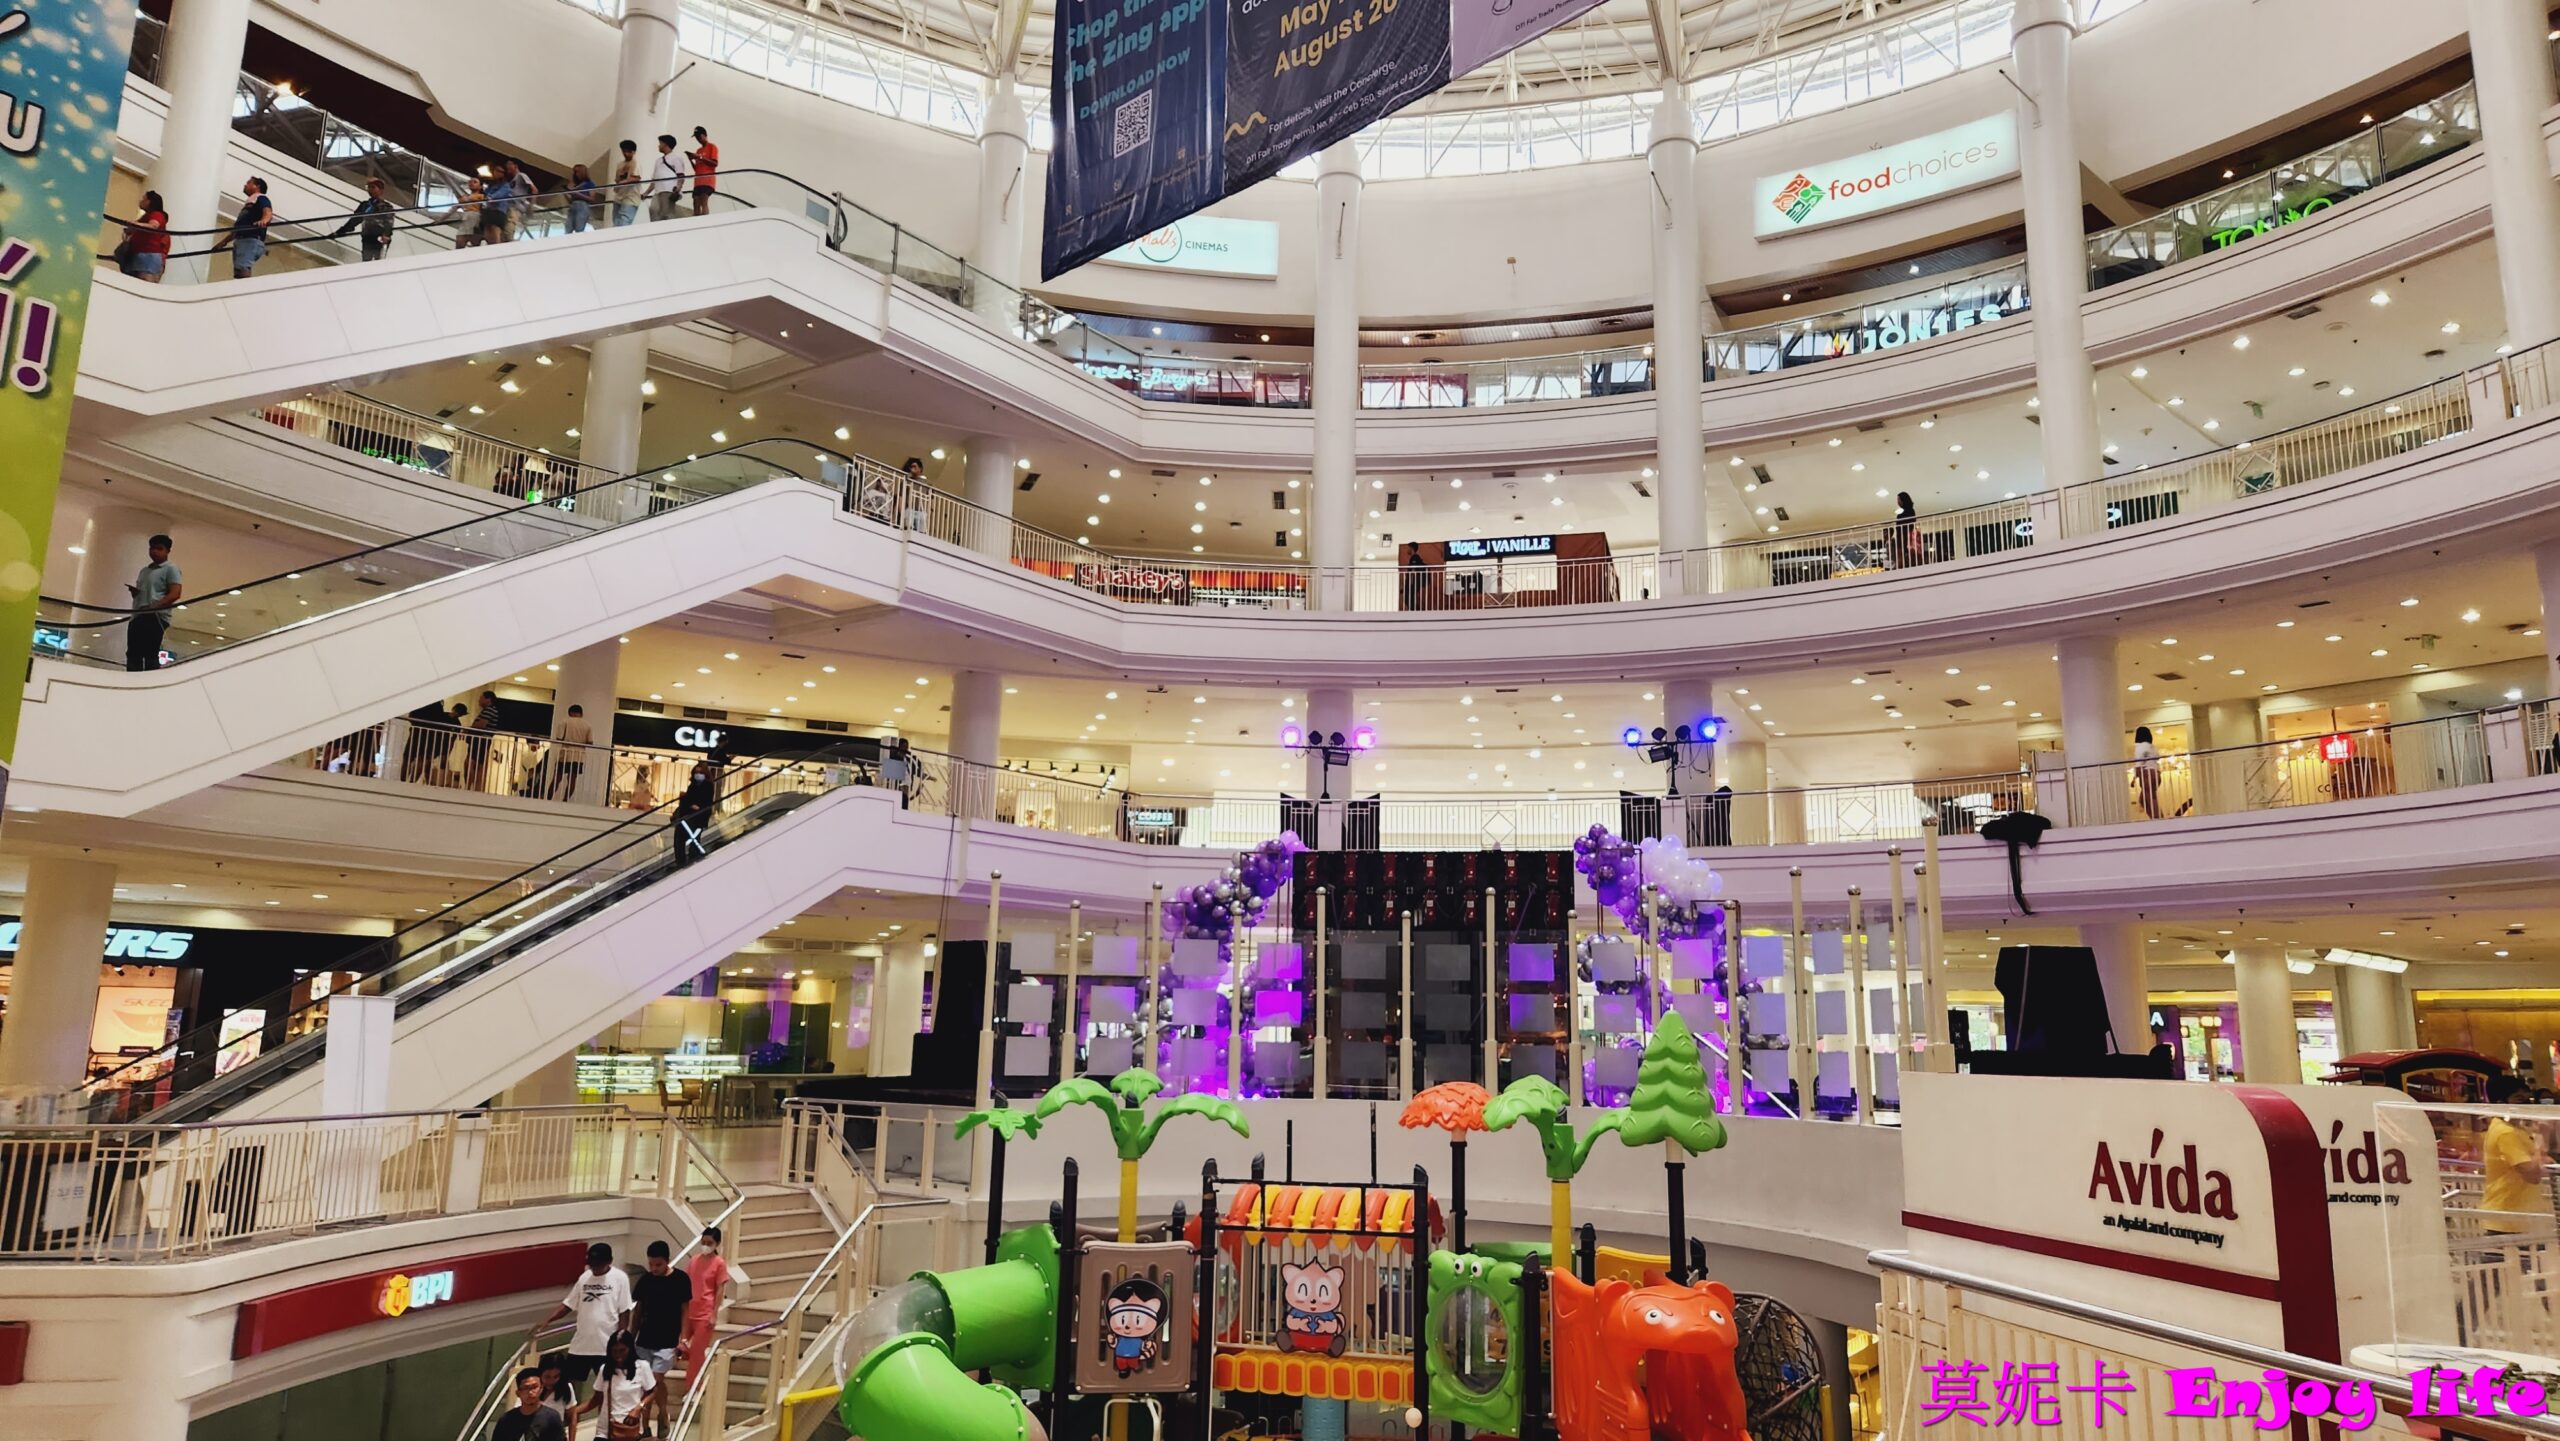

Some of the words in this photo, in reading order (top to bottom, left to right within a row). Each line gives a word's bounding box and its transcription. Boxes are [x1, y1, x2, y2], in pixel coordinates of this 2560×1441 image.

[1066, 9, 1118, 49] Shop
[1280, 0, 1332, 38] May
[1064, 57, 1097, 90] the
[1102, 22, 1153, 67] Zing
[1159, 0, 1207, 33] app
[1273, 9, 1364, 78] August
[1080, 69, 1154, 120] DOWNLOAD
[1157, 48, 1191, 75] NOW
[1293, 126, 1316, 142] Permit
[1409, 64, 1429, 80] 2023
[1269, 121, 1284, 134] For
[1334, 87, 1348, 101] the
[1185, 240, 1228, 252] CINEMAS
[1491, 537, 1551, 553] VANILLE
[2169, 1226, 2225, 1249] company
[409, 1270, 454, 1308] BPI
